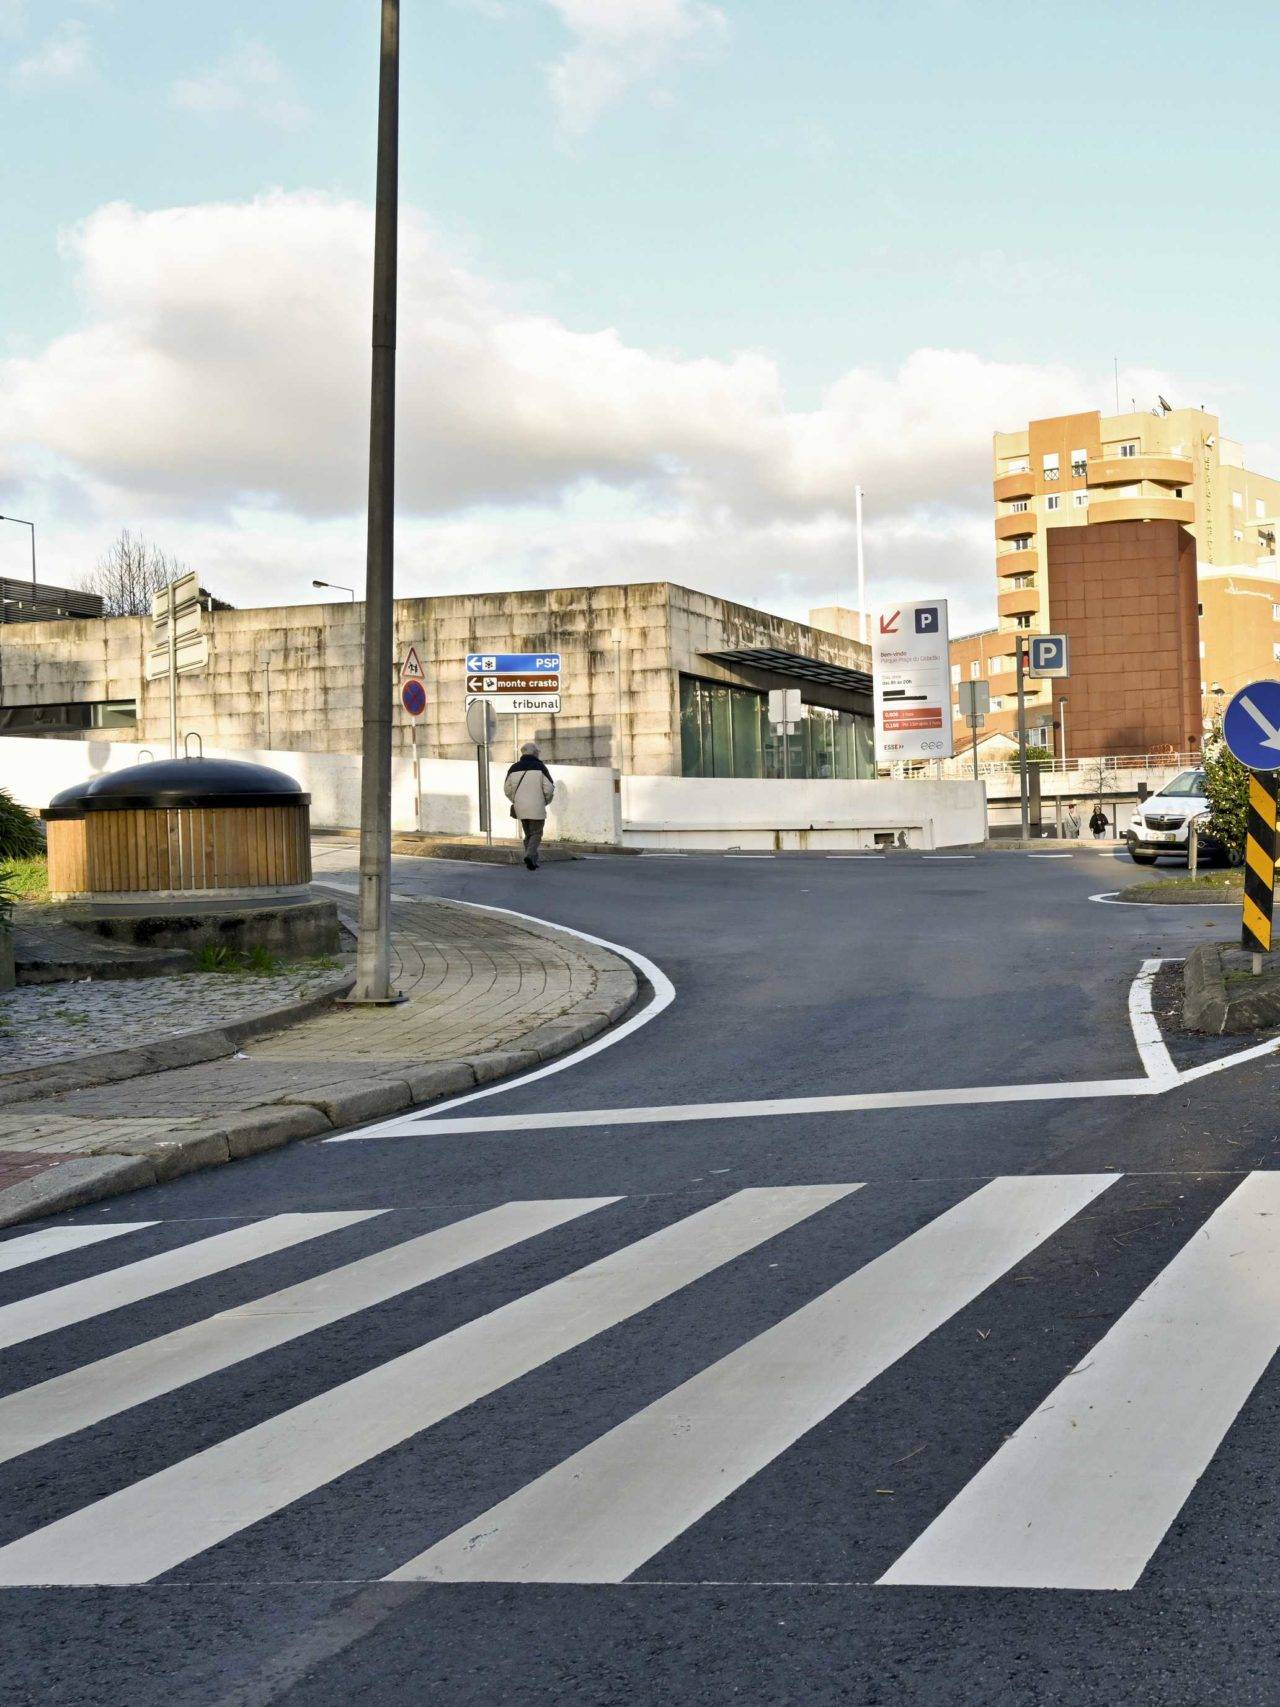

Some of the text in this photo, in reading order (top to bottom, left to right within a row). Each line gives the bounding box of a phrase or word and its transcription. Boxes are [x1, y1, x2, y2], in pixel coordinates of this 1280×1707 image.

[921, 613, 932, 629] P
[1040, 643, 1057, 666] P
[536, 658, 559, 669] PSP
[498, 679, 558, 688] monte crasto
[513, 699, 559, 709] tribunal
